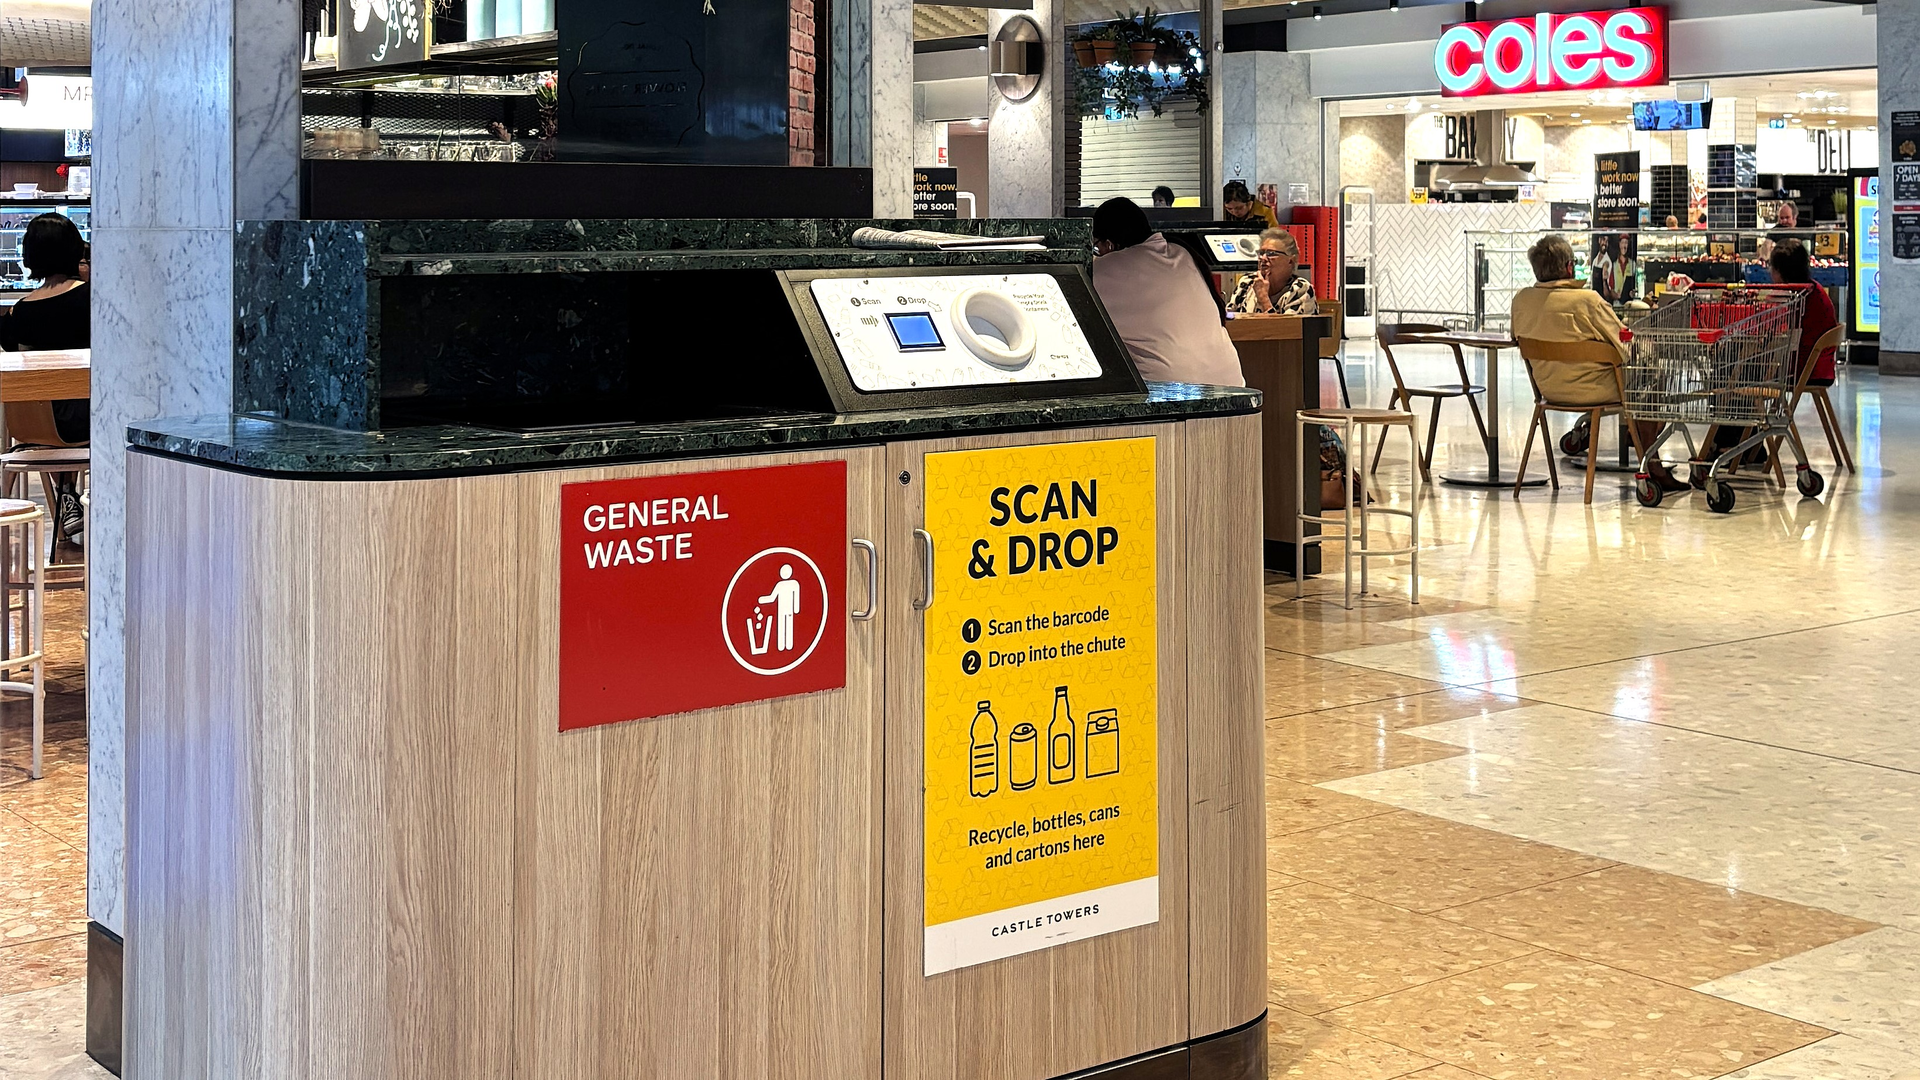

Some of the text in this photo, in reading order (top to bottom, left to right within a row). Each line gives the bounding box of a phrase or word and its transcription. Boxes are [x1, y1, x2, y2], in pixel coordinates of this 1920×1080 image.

[1434, 12, 1651, 92] coles
[1602, 171, 1621, 183] work
[1897, 166, 1919, 174] OPEN
[931, 203, 958, 211] soon.
[908, 296, 927, 305] Drop
[584, 494, 729, 532] GENERAL
[990, 479, 1097, 526] SCAN
[584, 532, 693, 569] WASTE
[968, 526, 1118, 580] & DROP
[988, 619, 1023, 636] Scan
[1026, 614, 1050, 631] the
[1053, 605, 1110, 628] barcode
[989, 651, 1026, 668] Drop
[1029, 645, 1058, 662] into
[1061, 640, 1084, 658] the
[1086, 636, 1126, 654] chute
[969, 806, 1120, 847] Recycle, bottles, cans
[985, 834, 1105, 870] and cartons here
[991, 904, 1100, 937] CASTLE TOWERS
